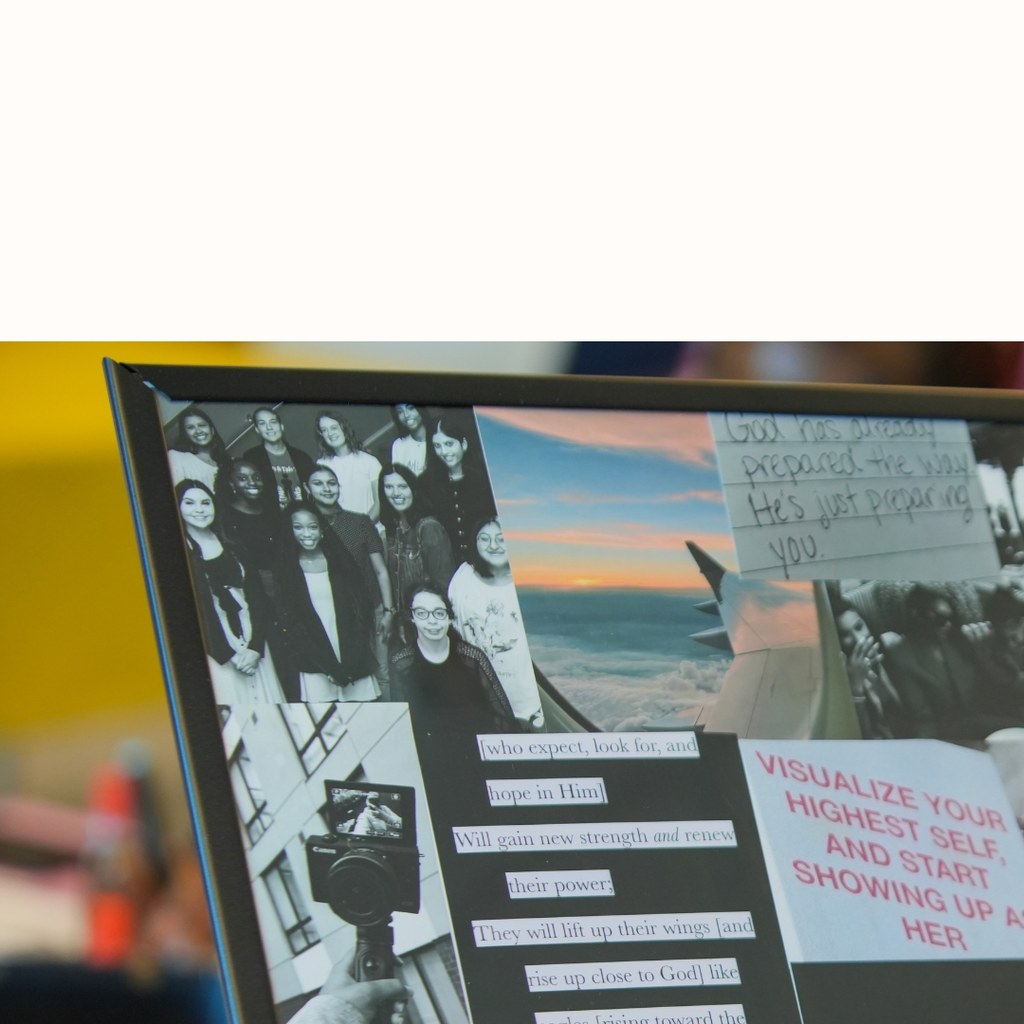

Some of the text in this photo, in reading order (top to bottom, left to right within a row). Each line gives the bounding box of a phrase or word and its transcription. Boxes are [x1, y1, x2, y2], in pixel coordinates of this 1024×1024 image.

[724, 413, 937, 447] God has already
[741, 447, 970, 489] prepared the way
[747, 483, 975, 530] He's just preparing
[769, 534, 825, 580] you.
[480, 736, 698, 761] [who expect, look for, and
[488, 782, 607, 806] hope in Him]
[755, 750, 1007, 833] VISUALIZE YOUR
[454, 827, 736, 852] Will gain new strength and renew
[785, 790, 1007, 867] HIGHEST SELF,
[826, 832, 990, 890] AND START
[508, 876, 614, 897] their power;
[791, 858, 948, 914] SHOWING
[953, 894, 994, 922] UP
[474, 916, 755, 945] They will lift up their wings [and
[901, 916, 969, 952] HER
[527, 963, 739, 990] rise up close to God] like
